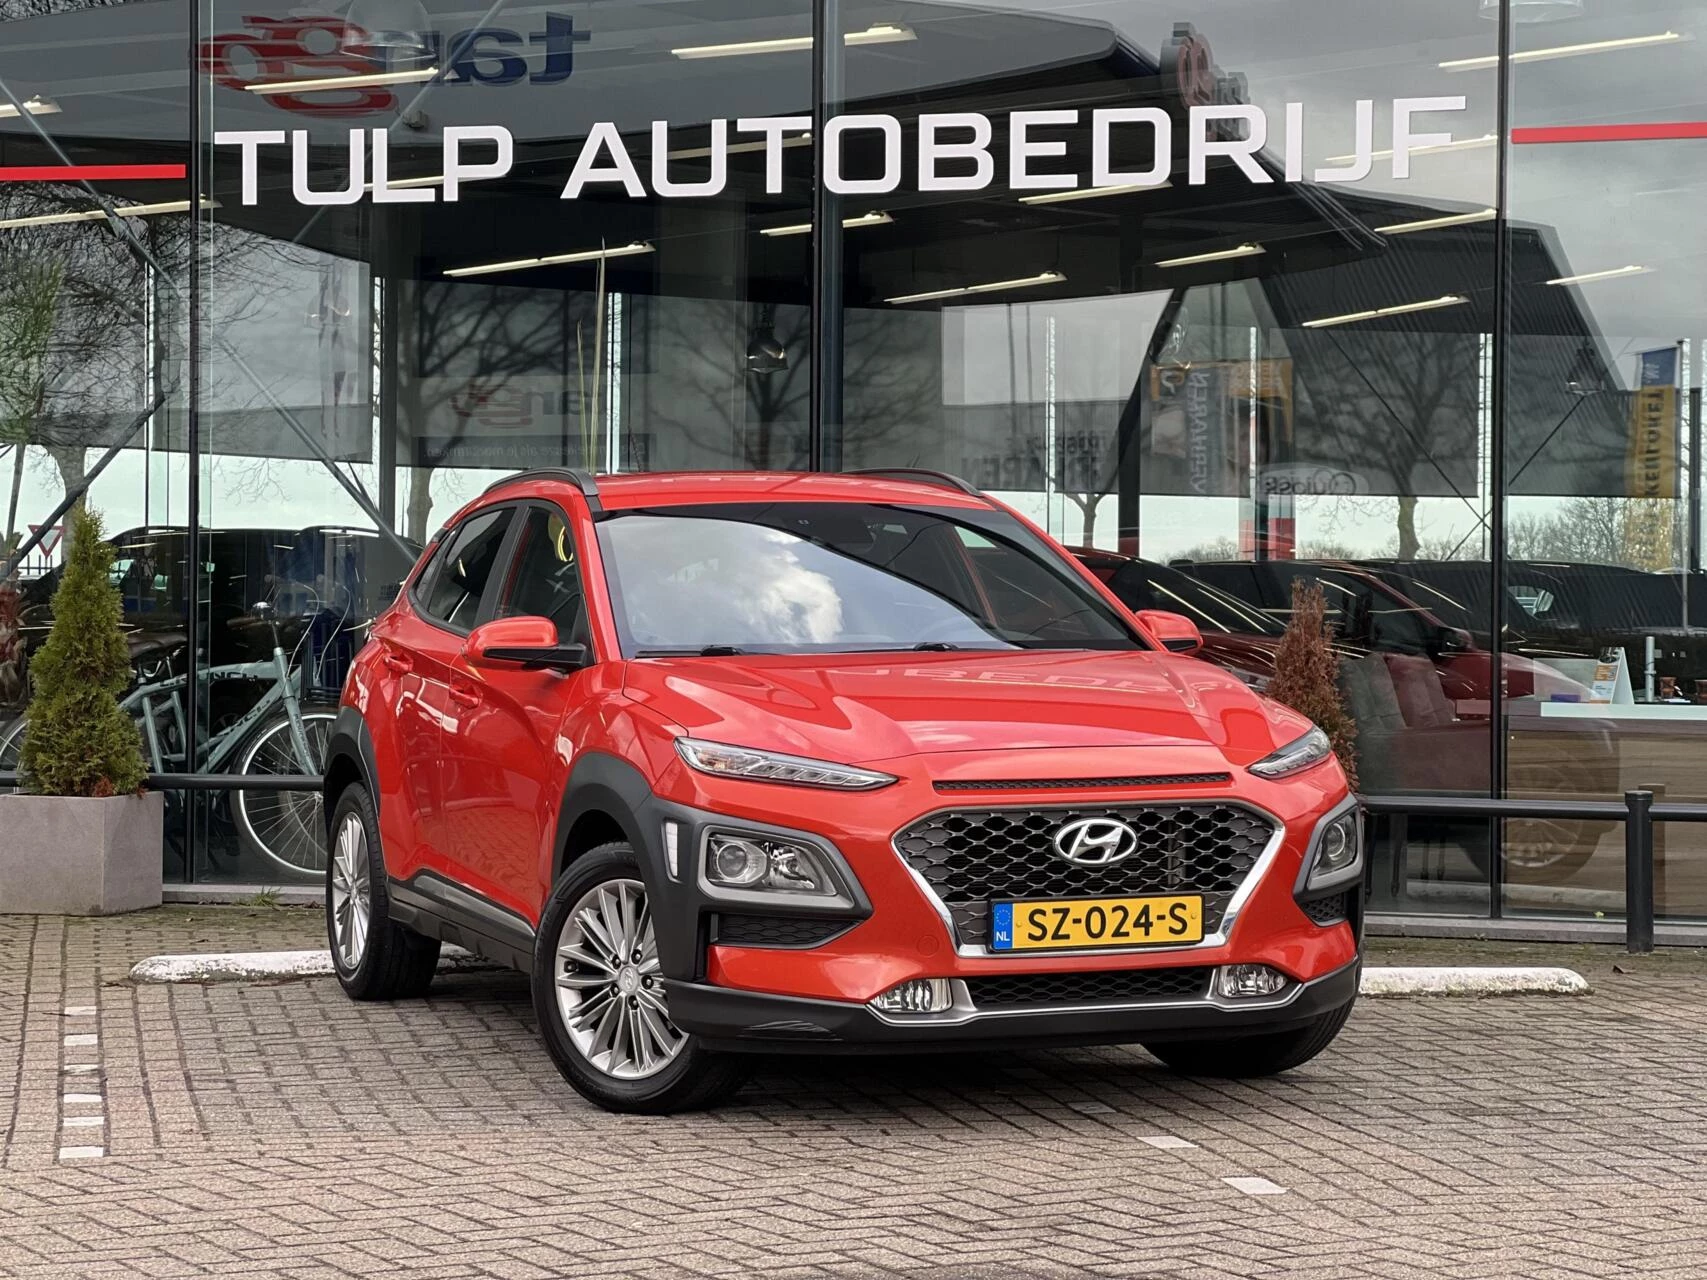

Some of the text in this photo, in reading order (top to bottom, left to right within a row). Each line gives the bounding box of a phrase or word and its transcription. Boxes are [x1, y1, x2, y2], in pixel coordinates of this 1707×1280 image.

[213, 95, 1468, 206] TULP AUTOBEDRIJF
[996, 902, 1188, 942] NL SZ-024-S
